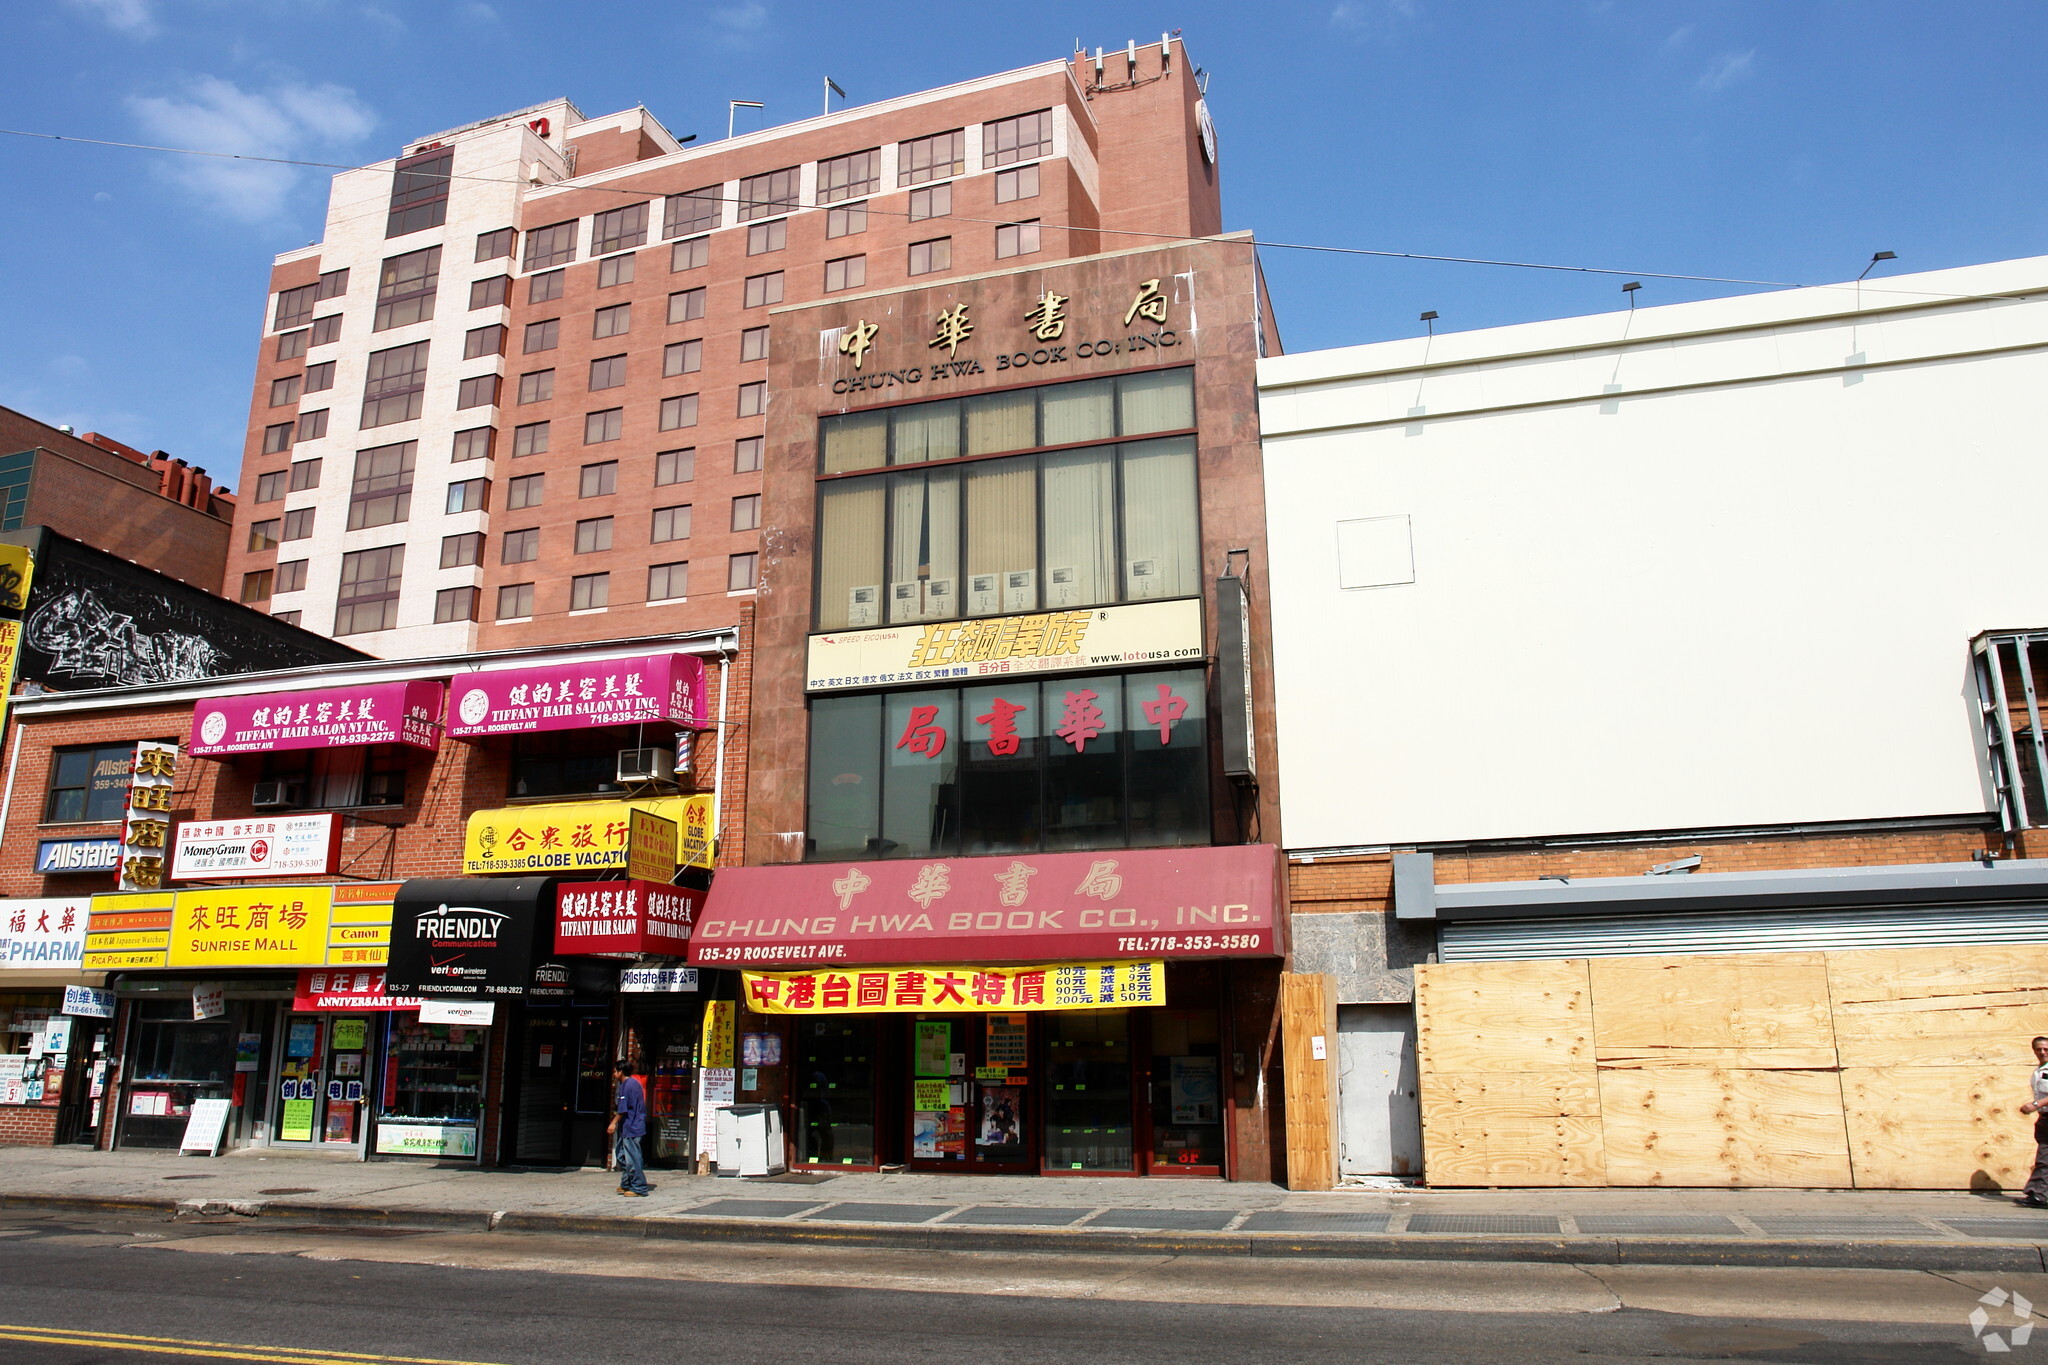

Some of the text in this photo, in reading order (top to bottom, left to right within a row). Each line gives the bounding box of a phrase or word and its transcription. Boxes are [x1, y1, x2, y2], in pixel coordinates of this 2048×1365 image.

[840, 279, 1168, 370] 中華書局
[832, 367, 923, 394] CHUNG
[931, 359, 984, 380] HWA
[996, 346, 1067, 370] BOOK
[1127, 331, 1182, 351] INC.
[978, 663, 1010, 674] 百分百
[810, 679, 825, 687] 中文
[828, 678, 843, 686] 英文
[845, 677, 859, 685] 日文
[897, 672, 913, 681] 法文
[915, 671, 931, 679] 西文
[492, 697, 660, 722] TIFFANY HAIR SALON NY INC.
[590, 709, 660, 724] 718-939-2275
[235, 720, 389, 742] TIFFANY HAIR SALON NY INC.
[452, 725, 472, 735] 135-27
[487, 722, 523, 733] ROOSEVELT
[524, 721, 537, 730] AVE
[328, 732, 395, 745] 718-939-2275
[193, 744, 212, 754] 135-27
[226, 742, 260, 752] ROOSEVELT
[261, 741, 274, 749] AVE
[94, 759, 133, 776] Allsta
[640, 817, 669, 838] F.Y.C.
[688, 825, 704, 838] GLOBE
[183, 844, 245, 857] MoneyGram
[683, 837, 707, 851] VACATION
[43, 842, 119, 869] Allstate
[467, 859, 525, 871] TEL:718-539-3385
[527, 853, 571, 868] GLOBE
[274, 858, 324, 869] 718-539-5307
[833, 859, 1123, 910] 中華書局
[8, 906, 89, 934] 福大藥
[188, 901, 309, 932] 來旺商場
[701, 904, 1261, 938] CHUNG HWA BOOK CO., INC.
[341, 929, 379, 939] Canon
[416, 918, 503, 939] FRIENDLY
[560, 919, 637, 936] TIFFANY HAIR SALON
[647, 920, 692, 940] TIFFANY HAIR SALON
[191, 937, 298, 952] SUNRISE MALL
[432, 940, 497, 948] Communications
[1117, 934, 1260, 951] TEL:718-353-3580
[10, 941, 83, 961] PHARM
[342, 949, 389, 962] 喜寶仙
[698, 944, 847, 961] 135-29 ROOSEVELT AVE.
[535, 970, 570, 982] FRIENDLY
[1056, 963, 1152, 976] 30元 減 3元
[1055, 972, 1152, 985] 60元 減 9元
[418, 985, 477, 993] FRIENDLYCOMM.COM
[751, 971, 1046, 1008] 中港台圖書大特價
[1055, 982, 1152, 995] 90元 減 18元
[317, 995, 394, 1007] ANNIVERSARY
[1055, 992, 1152, 1005] 200元 減 50元
[447, 1008, 472, 1017] verizon
[666, 1045, 690, 1053] Allstate
